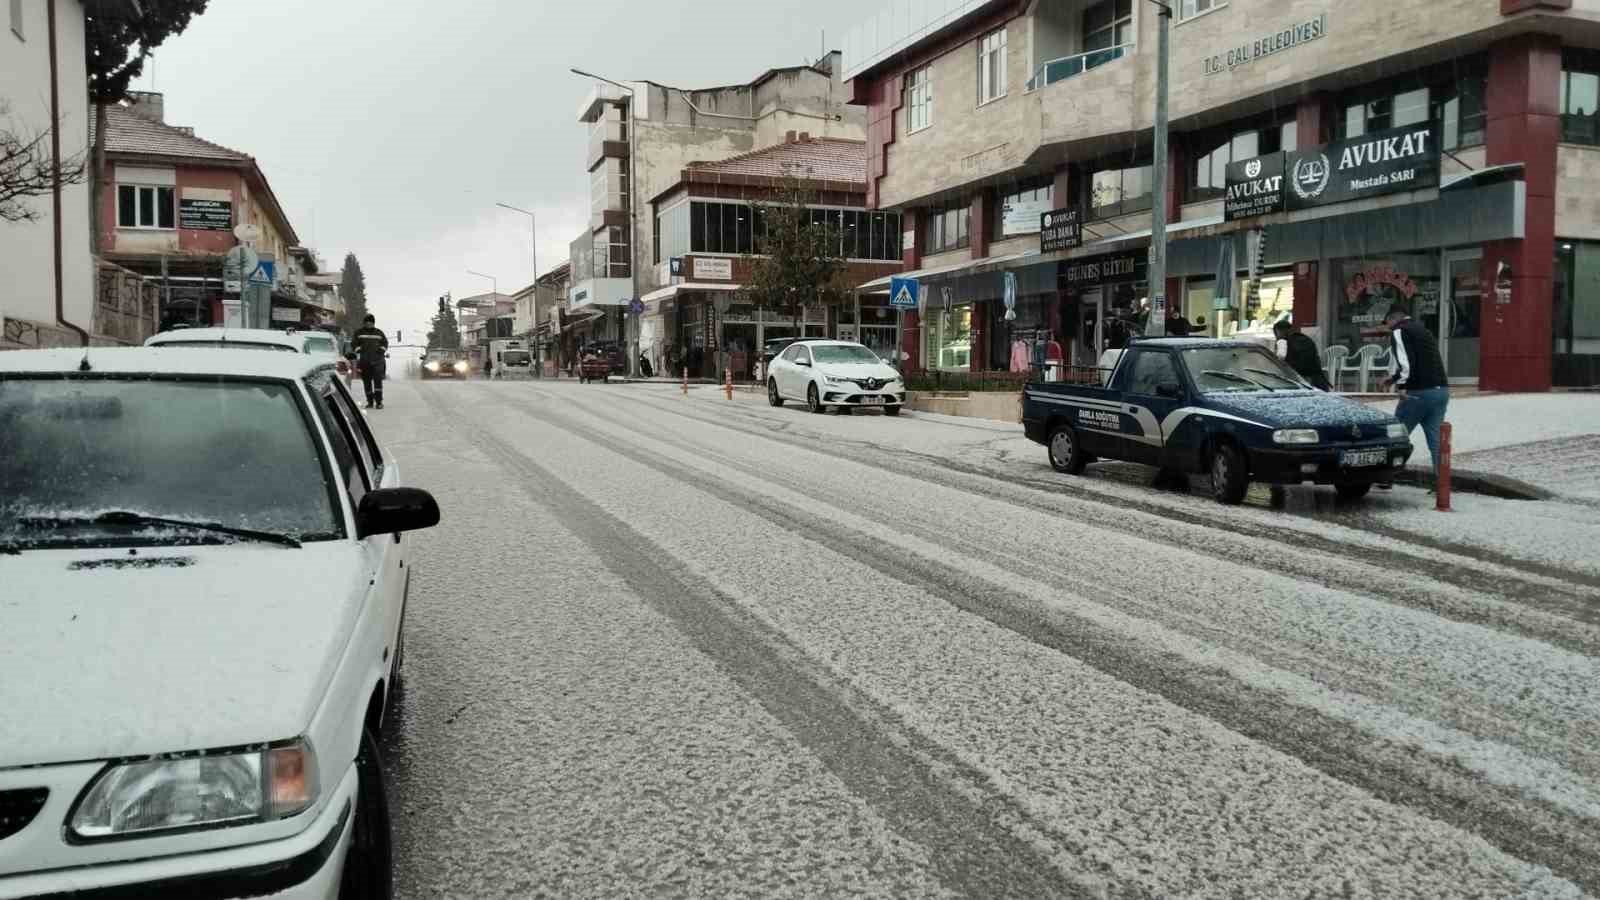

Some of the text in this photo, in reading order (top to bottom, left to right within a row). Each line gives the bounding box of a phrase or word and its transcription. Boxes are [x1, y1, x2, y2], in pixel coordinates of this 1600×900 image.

[1253, 13, 1325, 57] BELEDİYESİ
[1338, 129, 1430, 170] AVUKAT
[1226, 175, 1282, 200] AVUKAT
[1350, 168, 1415, 190] Mustafa SARI
[1052, 211, 1077, 224] AVUKAT
